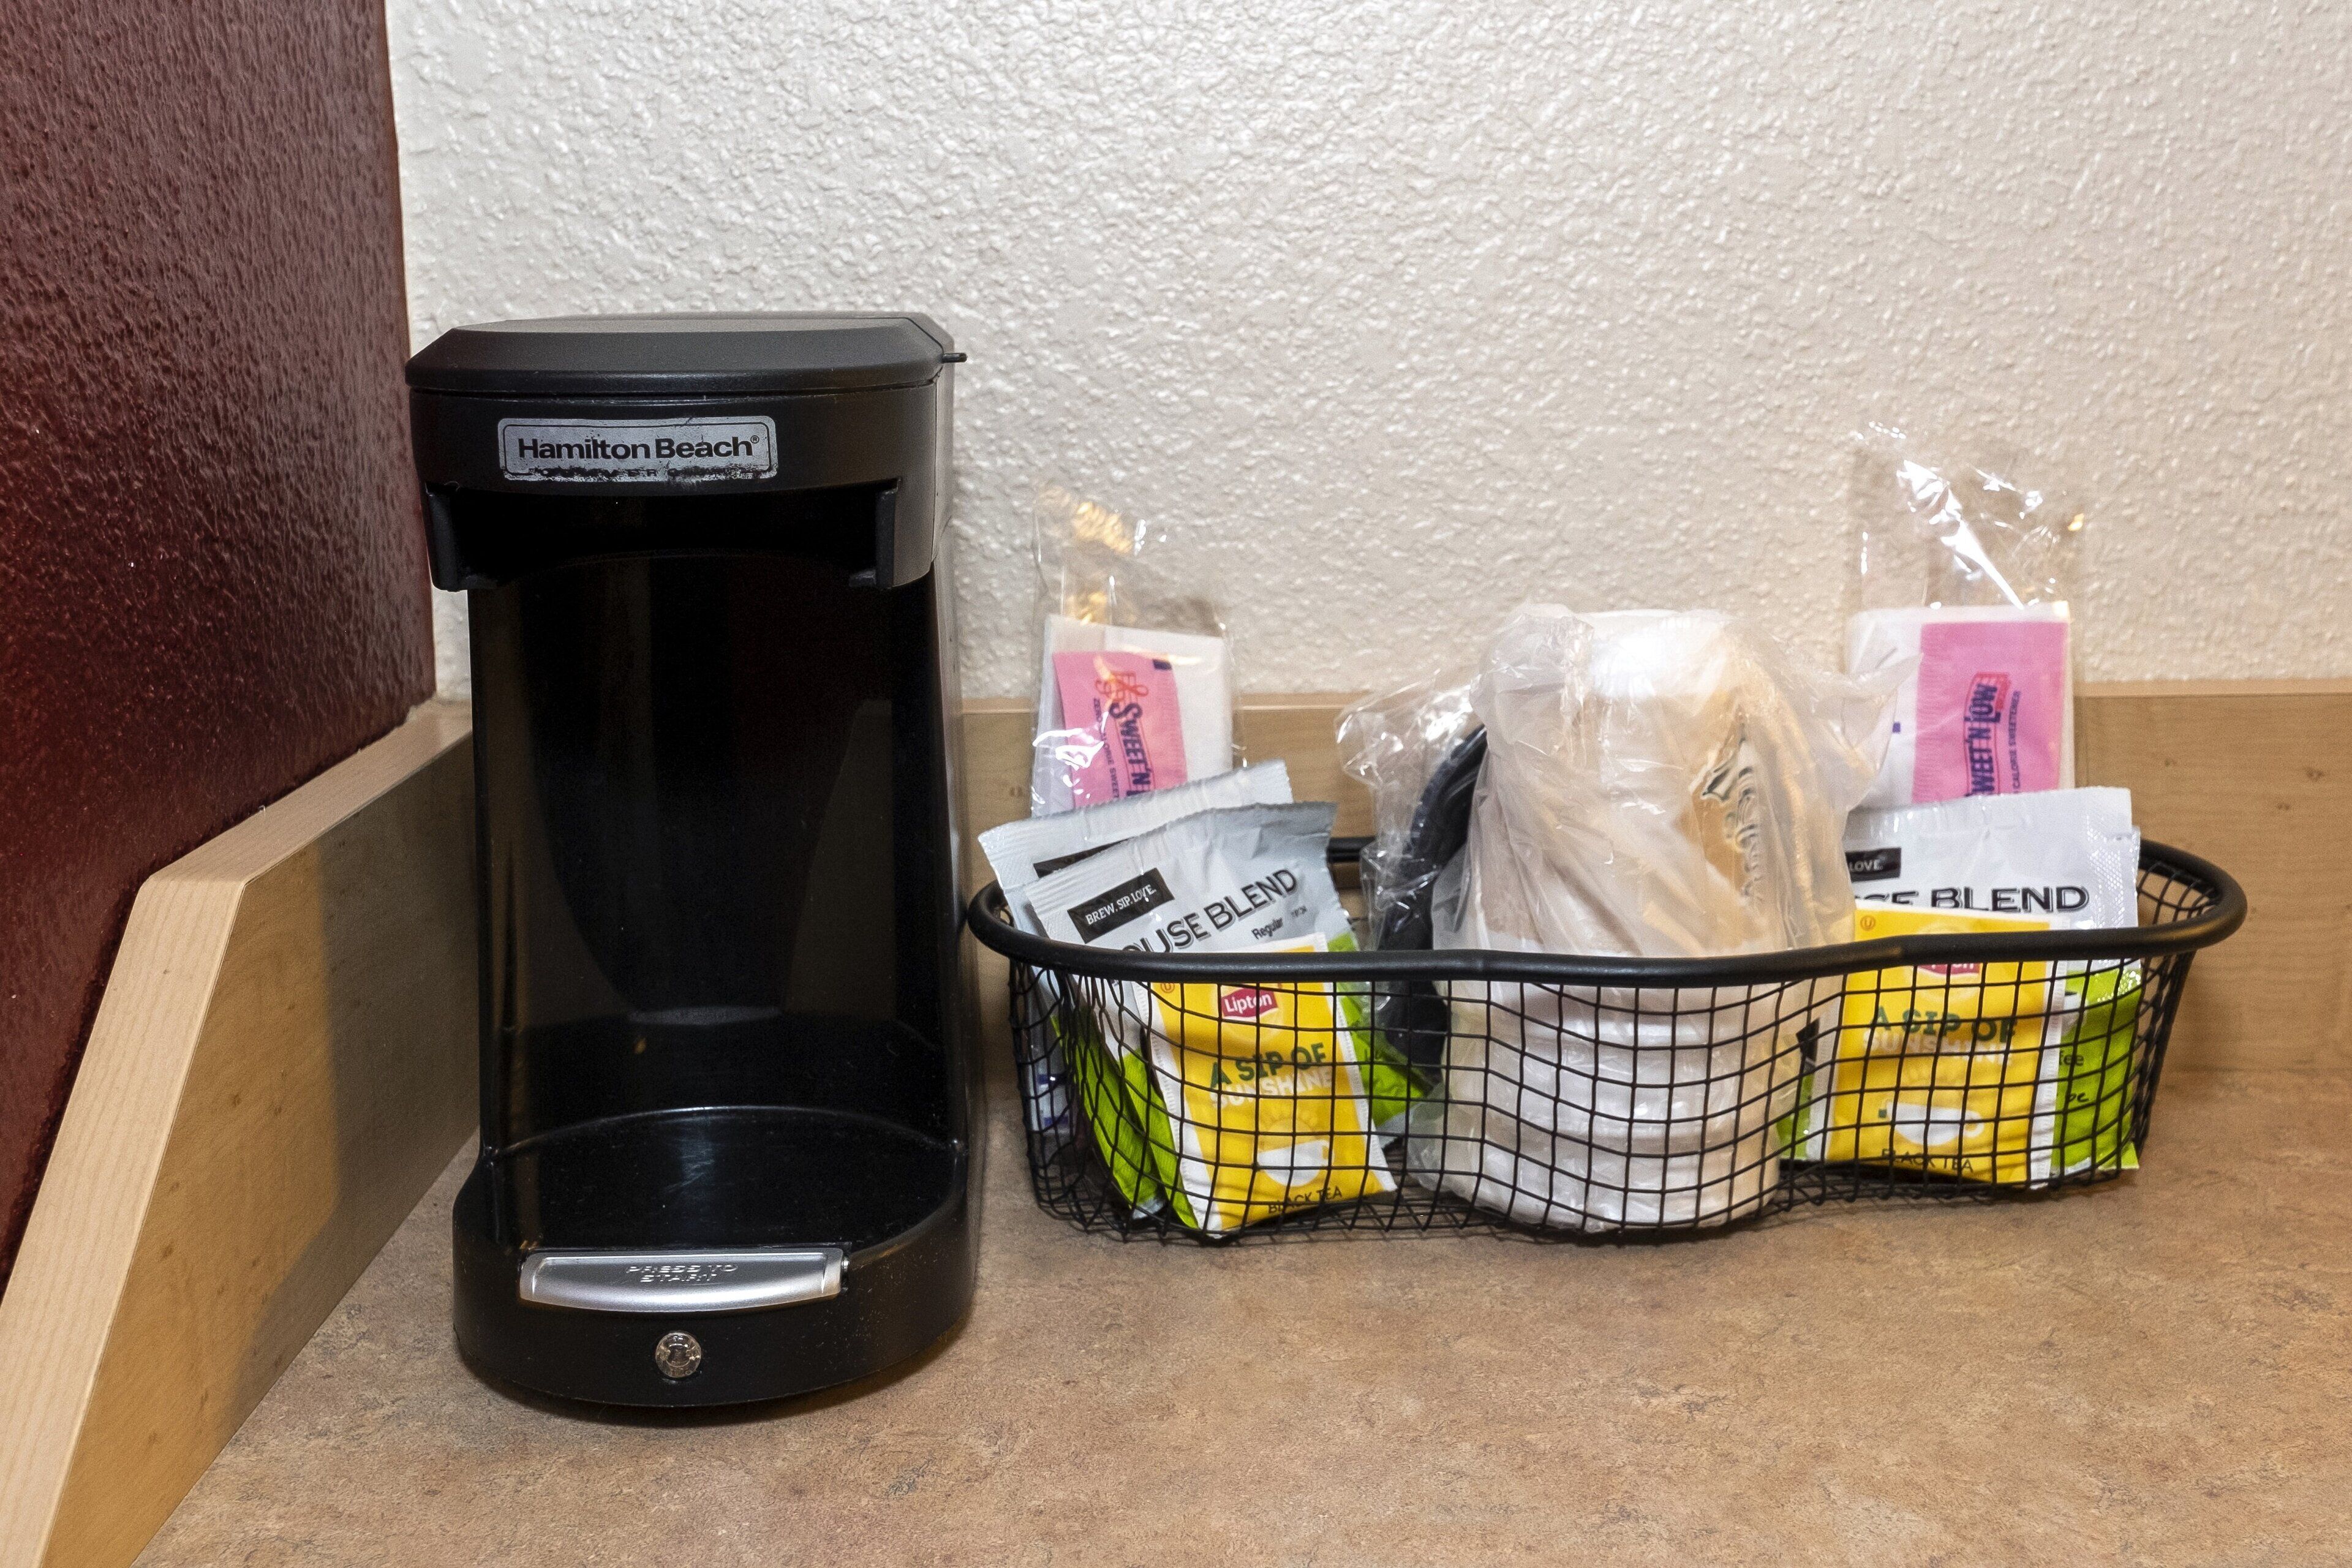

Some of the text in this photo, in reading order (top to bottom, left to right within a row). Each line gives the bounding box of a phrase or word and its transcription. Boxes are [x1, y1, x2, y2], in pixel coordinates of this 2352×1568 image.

[518, 437, 652, 460] Hamilton
[1964, 727, 1995, 797] WEET'N
[1085, 884, 1157, 925] BREW. SIP. LOVE.
[1204, 869, 1300, 932] BLEND
[1931, 885, 2089, 913] BLEND
[1251, 917, 1284, 940] Regular
[1224, 993, 1273, 1014] Lipton
[1235, 1050, 1284, 1081] SIP
[1291, 1042, 1326, 1070] OF
